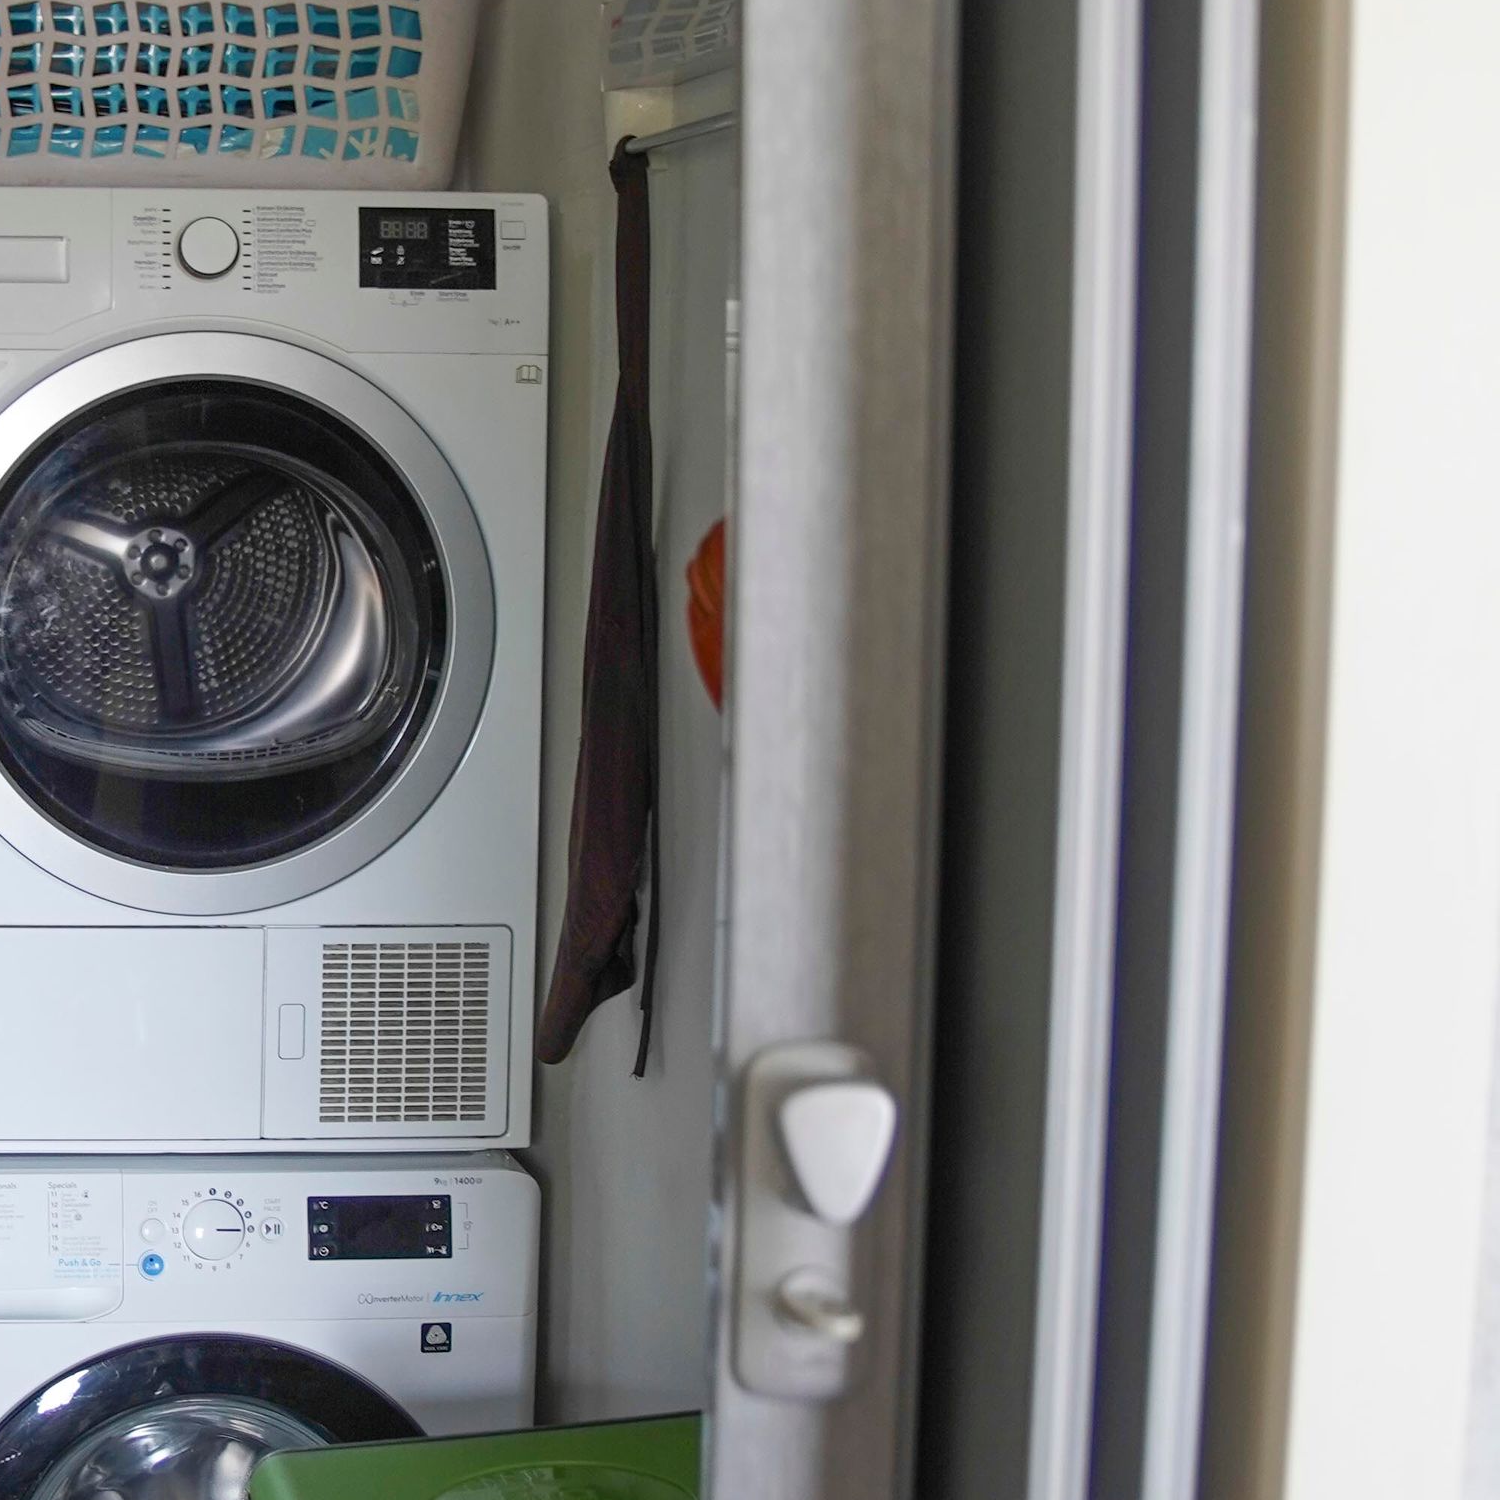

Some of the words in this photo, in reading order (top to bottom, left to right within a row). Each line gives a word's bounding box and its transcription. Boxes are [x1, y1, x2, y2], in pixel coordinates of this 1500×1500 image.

[454, 1177, 476, 1185] 1400
[48, 1182, 77, 1190] Specials
[58, 1259, 79, 1267] Push
[89, 1259, 102, 1267] Go
[432, 1291, 485, 1302] Innex
